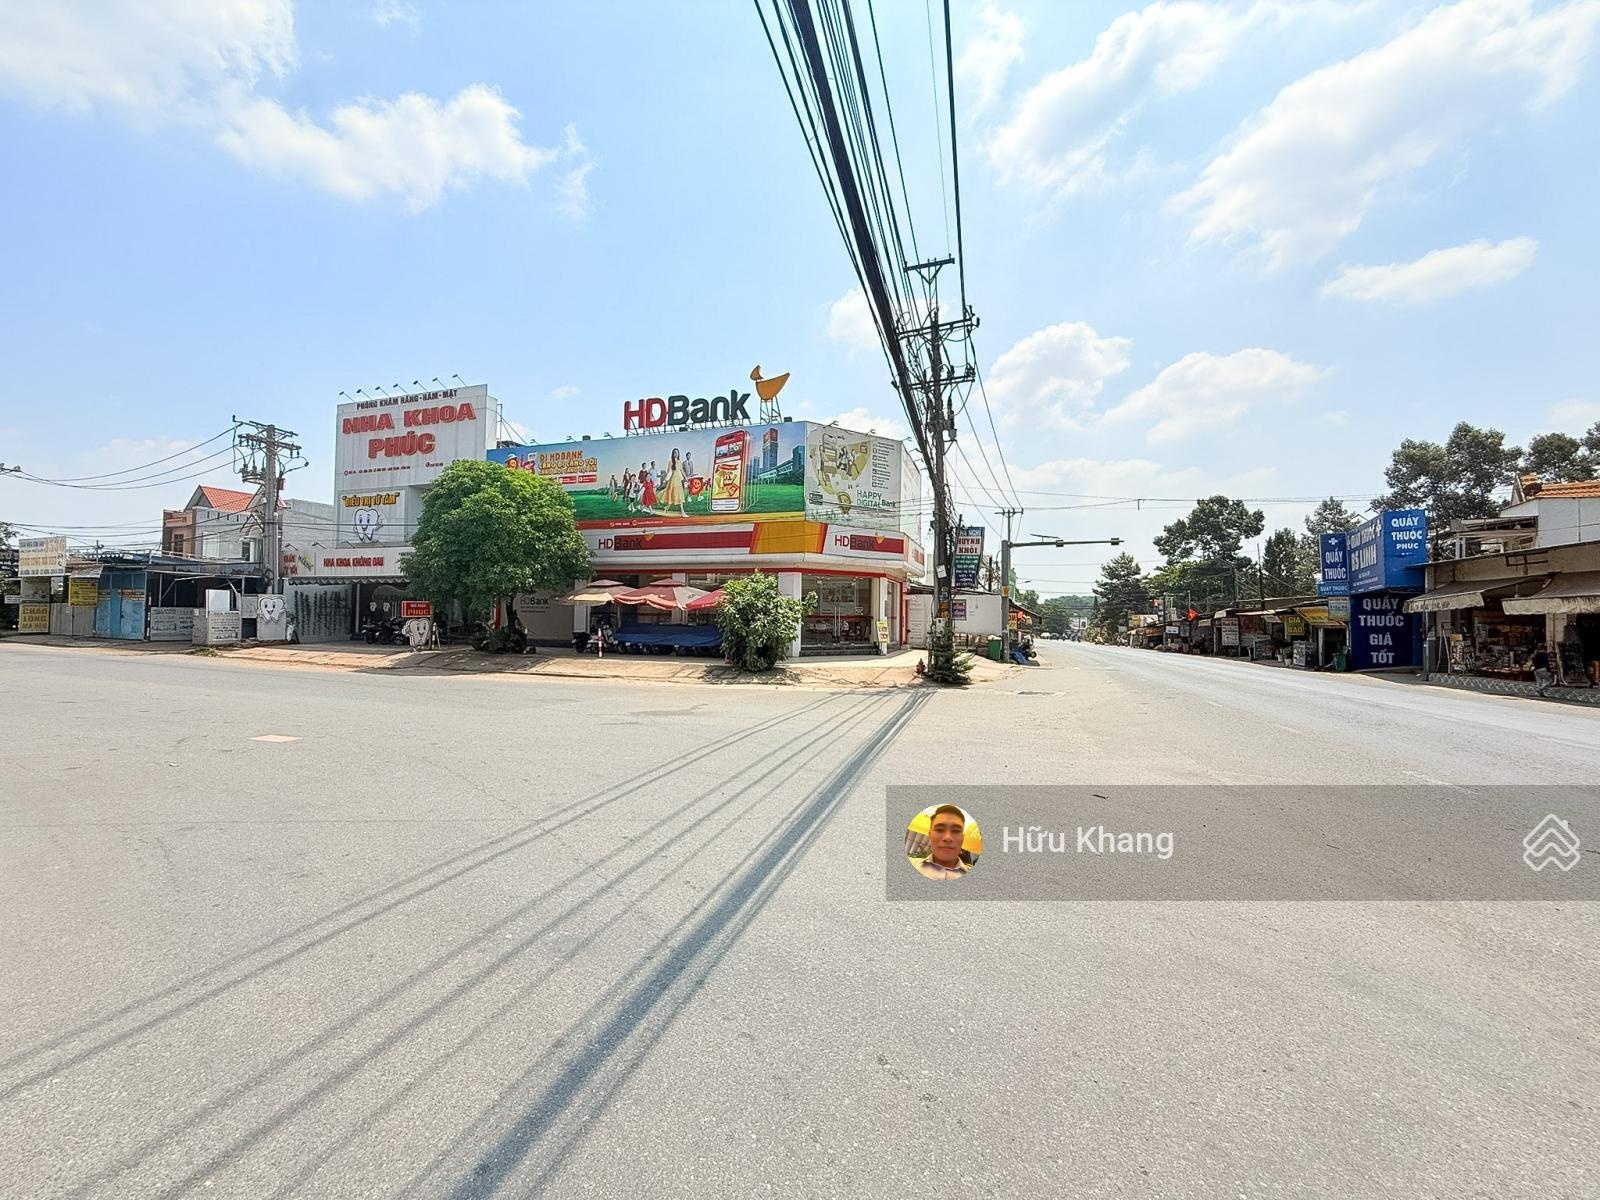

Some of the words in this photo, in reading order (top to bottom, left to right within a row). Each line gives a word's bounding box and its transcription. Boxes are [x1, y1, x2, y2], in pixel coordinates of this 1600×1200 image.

[624, 389, 751, 431] HDBank
[342, 413, 395, 435] NHA
[403, 402, 477, 428] KHOA
[367, 430, 436, 459] PHÚC
[856, 489, 882, 500] HAPPY
[598, 537, 643, 550] HDBank
[834, 534, 875, 550] HDBank
[1358, 611, 1404, 627] THUỐC
[1369, 631, 1393, 646] GIÁ
[1370, 648, 1395, 664] TỐT
